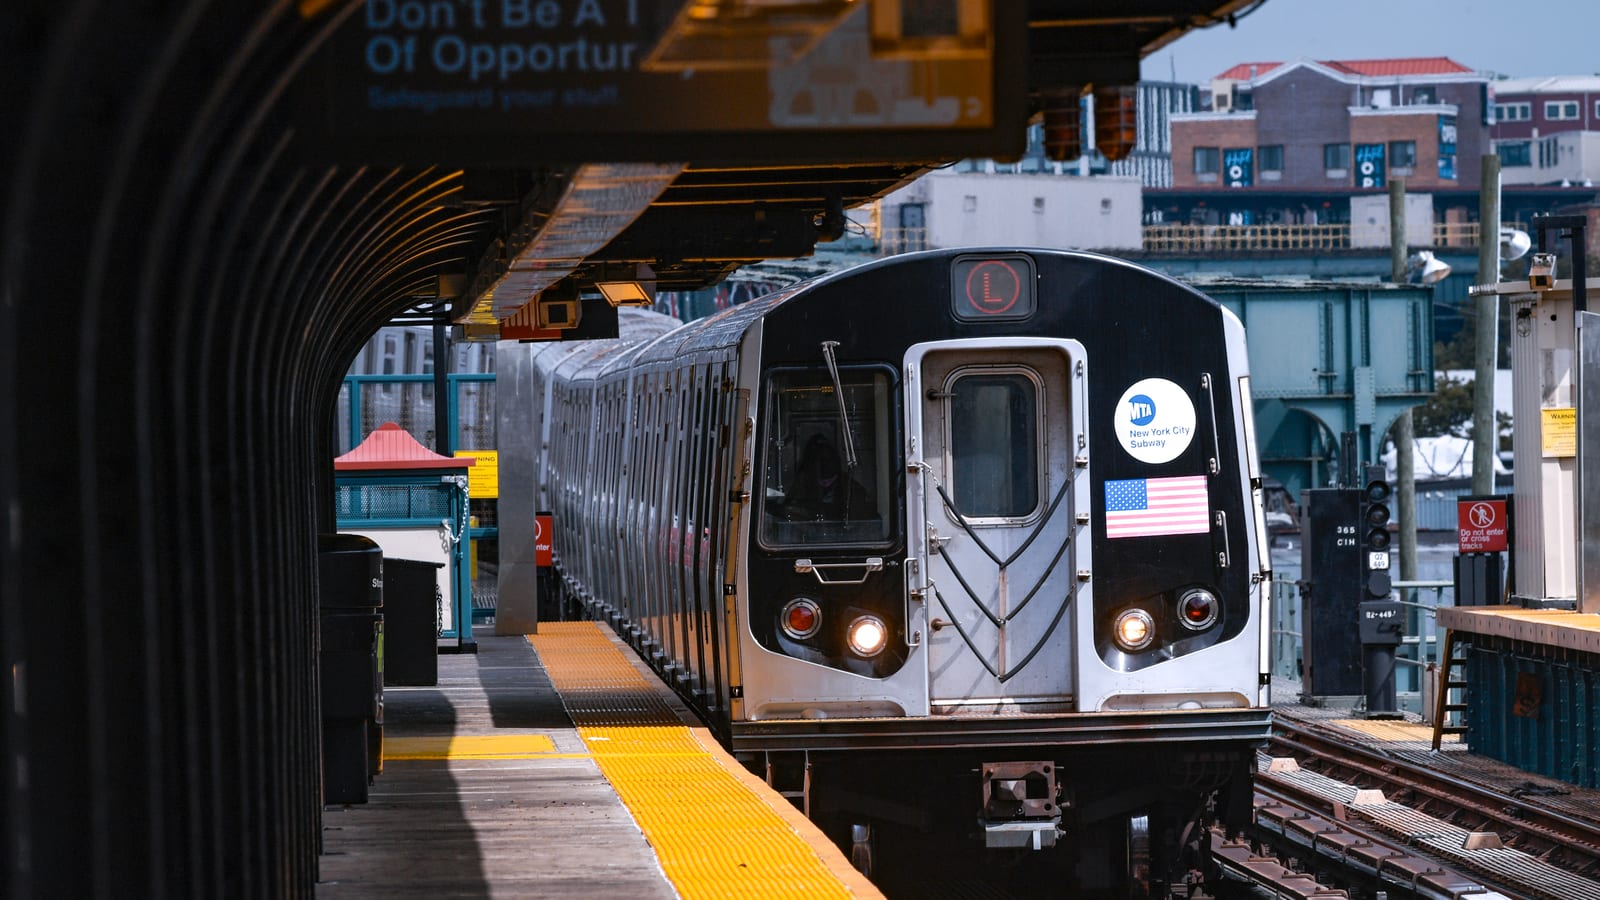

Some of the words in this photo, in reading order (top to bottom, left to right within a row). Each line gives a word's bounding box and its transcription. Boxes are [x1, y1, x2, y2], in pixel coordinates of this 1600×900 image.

[502, 0, 560, 30] Be
[574, 0, 605, 27] A
[365, 35, 417, 73] Of
[983, 272, 1002, 303] L
[1129, 402, 1152, 420] MTA
[1129, 430, 1149, 438] New
[1151, 427, 1171, 436] York
[1172, 425, 1190, 436] City
[1130, 440, 1166, 448] Subway
[1336, 526, 1356, 535] 365
[1461, 529, 1471, 537] Do
[1473, 528, 1484, 536] not
[1486, 528, 1505, 536] enter
